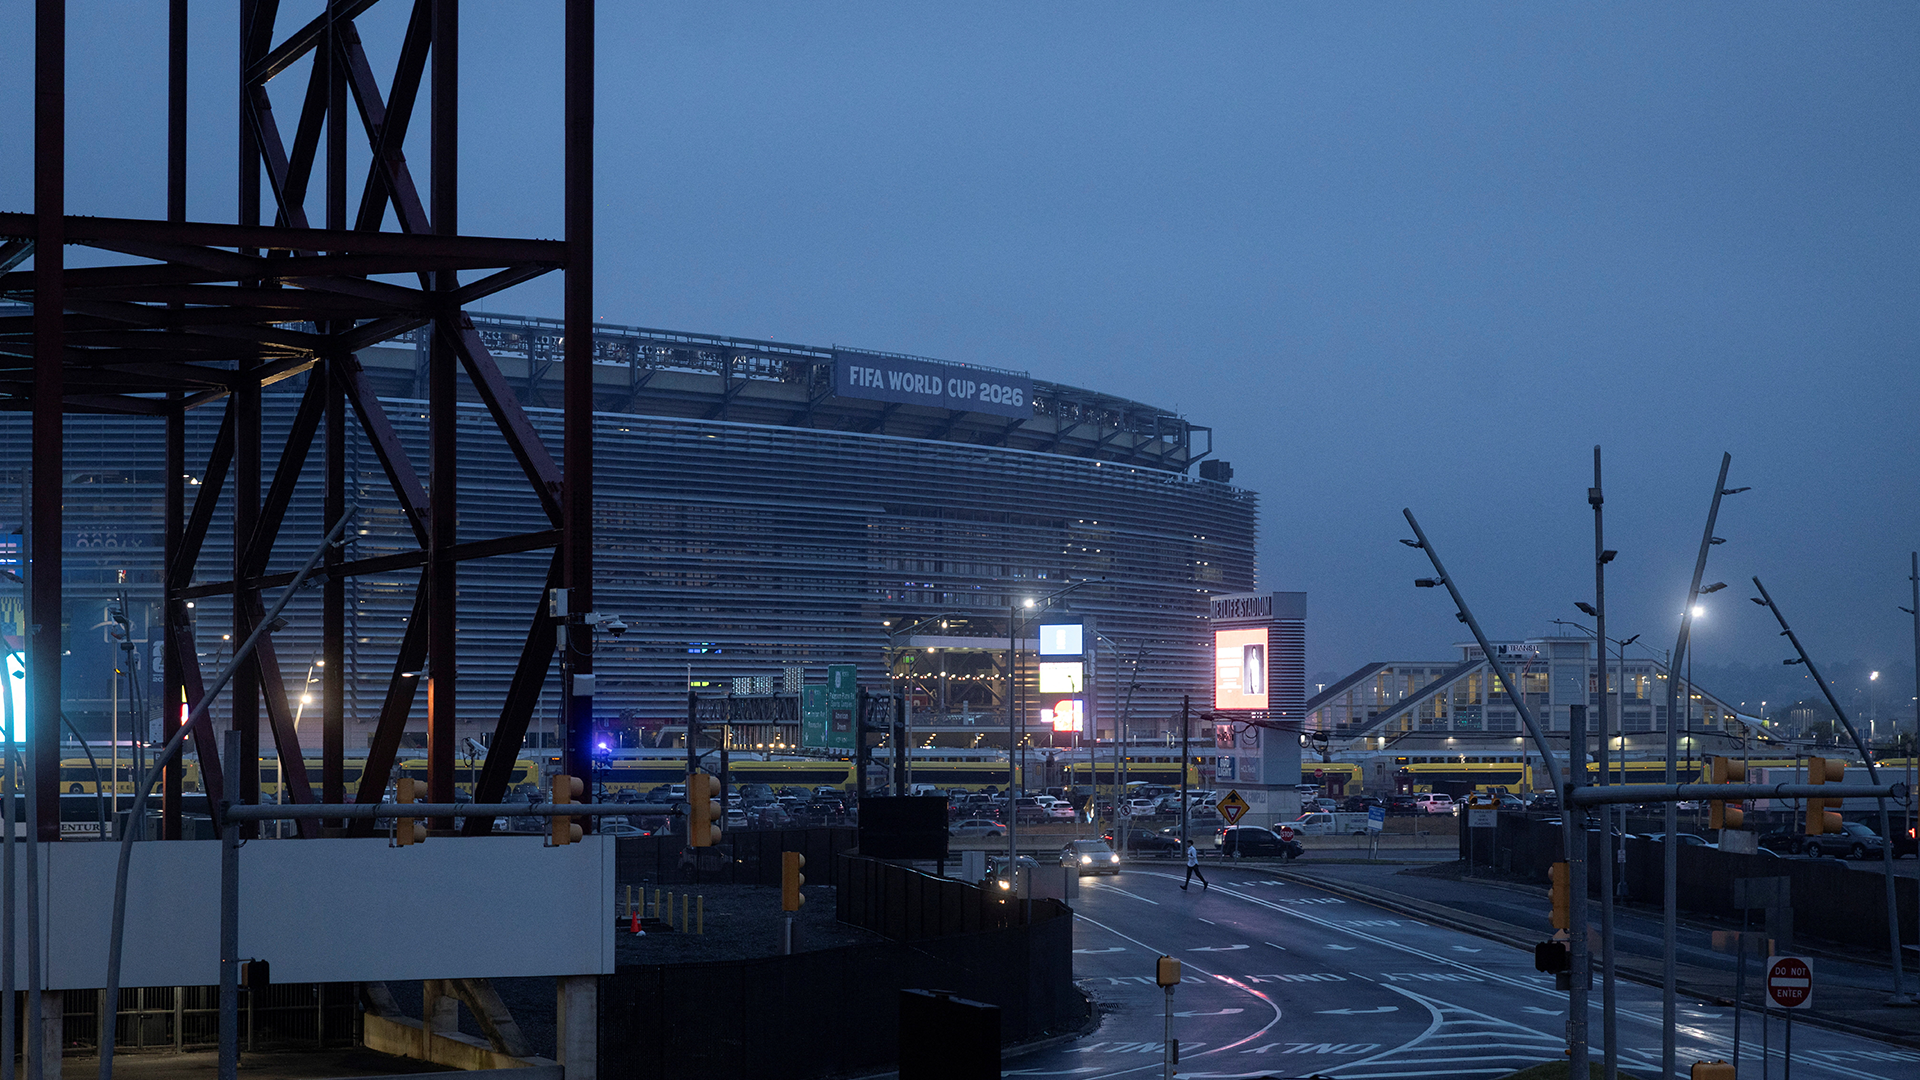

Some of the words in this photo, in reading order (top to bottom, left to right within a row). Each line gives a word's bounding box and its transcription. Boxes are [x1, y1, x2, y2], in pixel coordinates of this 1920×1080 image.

[849, 366, 884, 389] FIFA
[887, 371, 943, 396] WORLD
[947, 378, 977, 399] CUP
[979, 383, 1024, 408] 2026
[1240, 596, 1273, 618] STADIUM
[1774, 966, 1787, 976] DO
[1790, 967, 1807, 976] NOT
[1243, 972, 1348, 983] ONLY
[1380, 972, 1485, 982] ONLY
[1776, 989, 1803, 998] ENTER
[1238, 1042, 1382, 1055] ONLY
